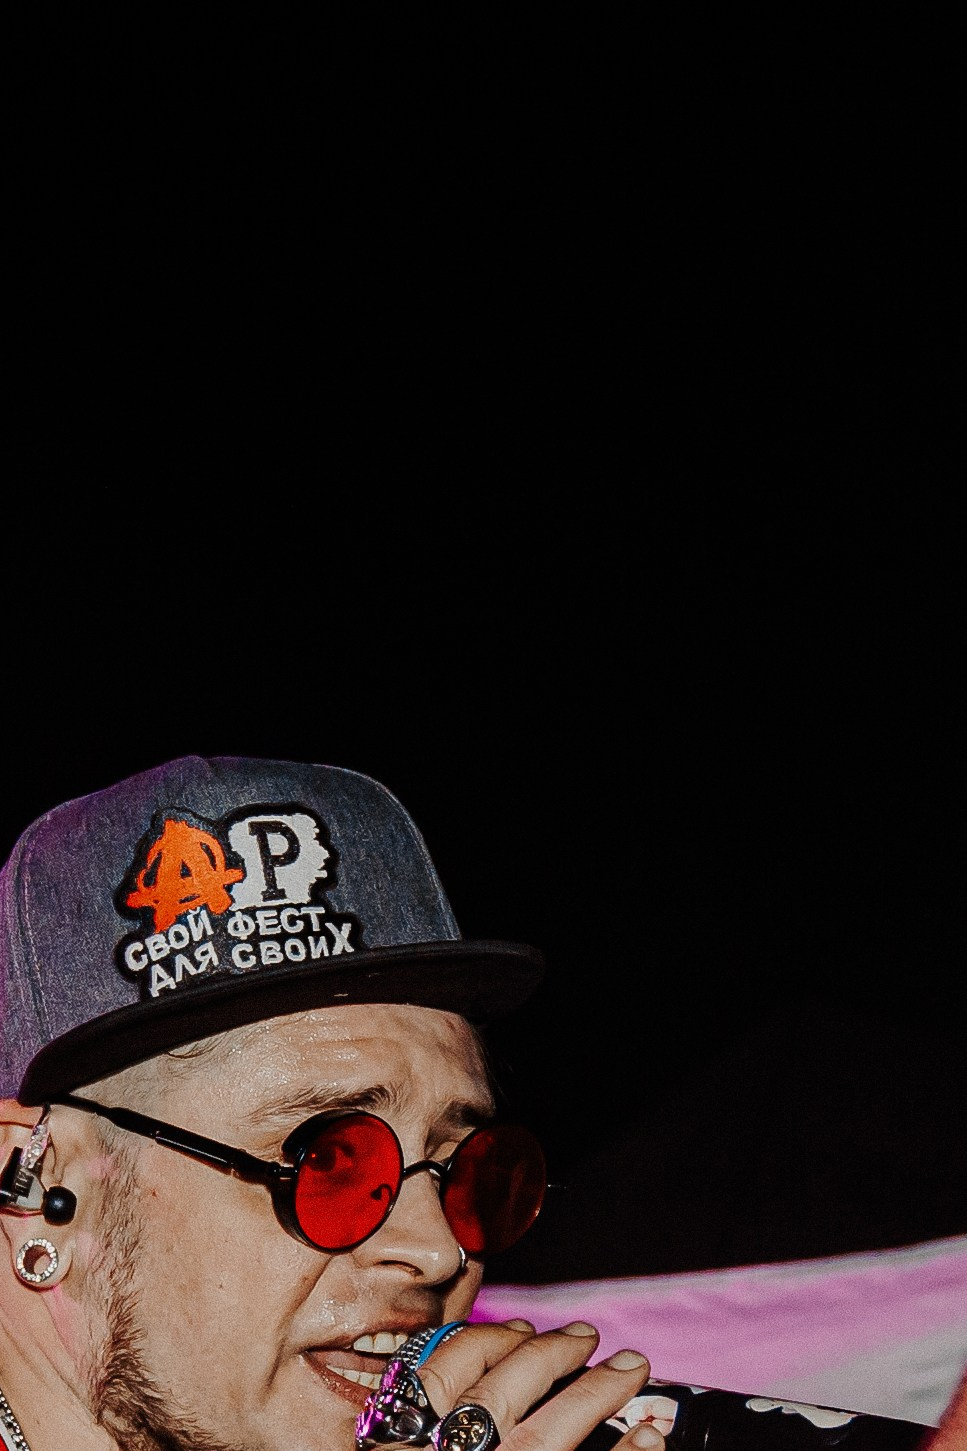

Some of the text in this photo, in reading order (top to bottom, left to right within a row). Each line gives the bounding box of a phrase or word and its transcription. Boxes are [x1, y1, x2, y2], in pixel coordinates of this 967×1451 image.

[124, 906, 326, 972] СВОЙ ФЕСТ
[148, 922, 355, 998] ДЛЯ СВОИХ
